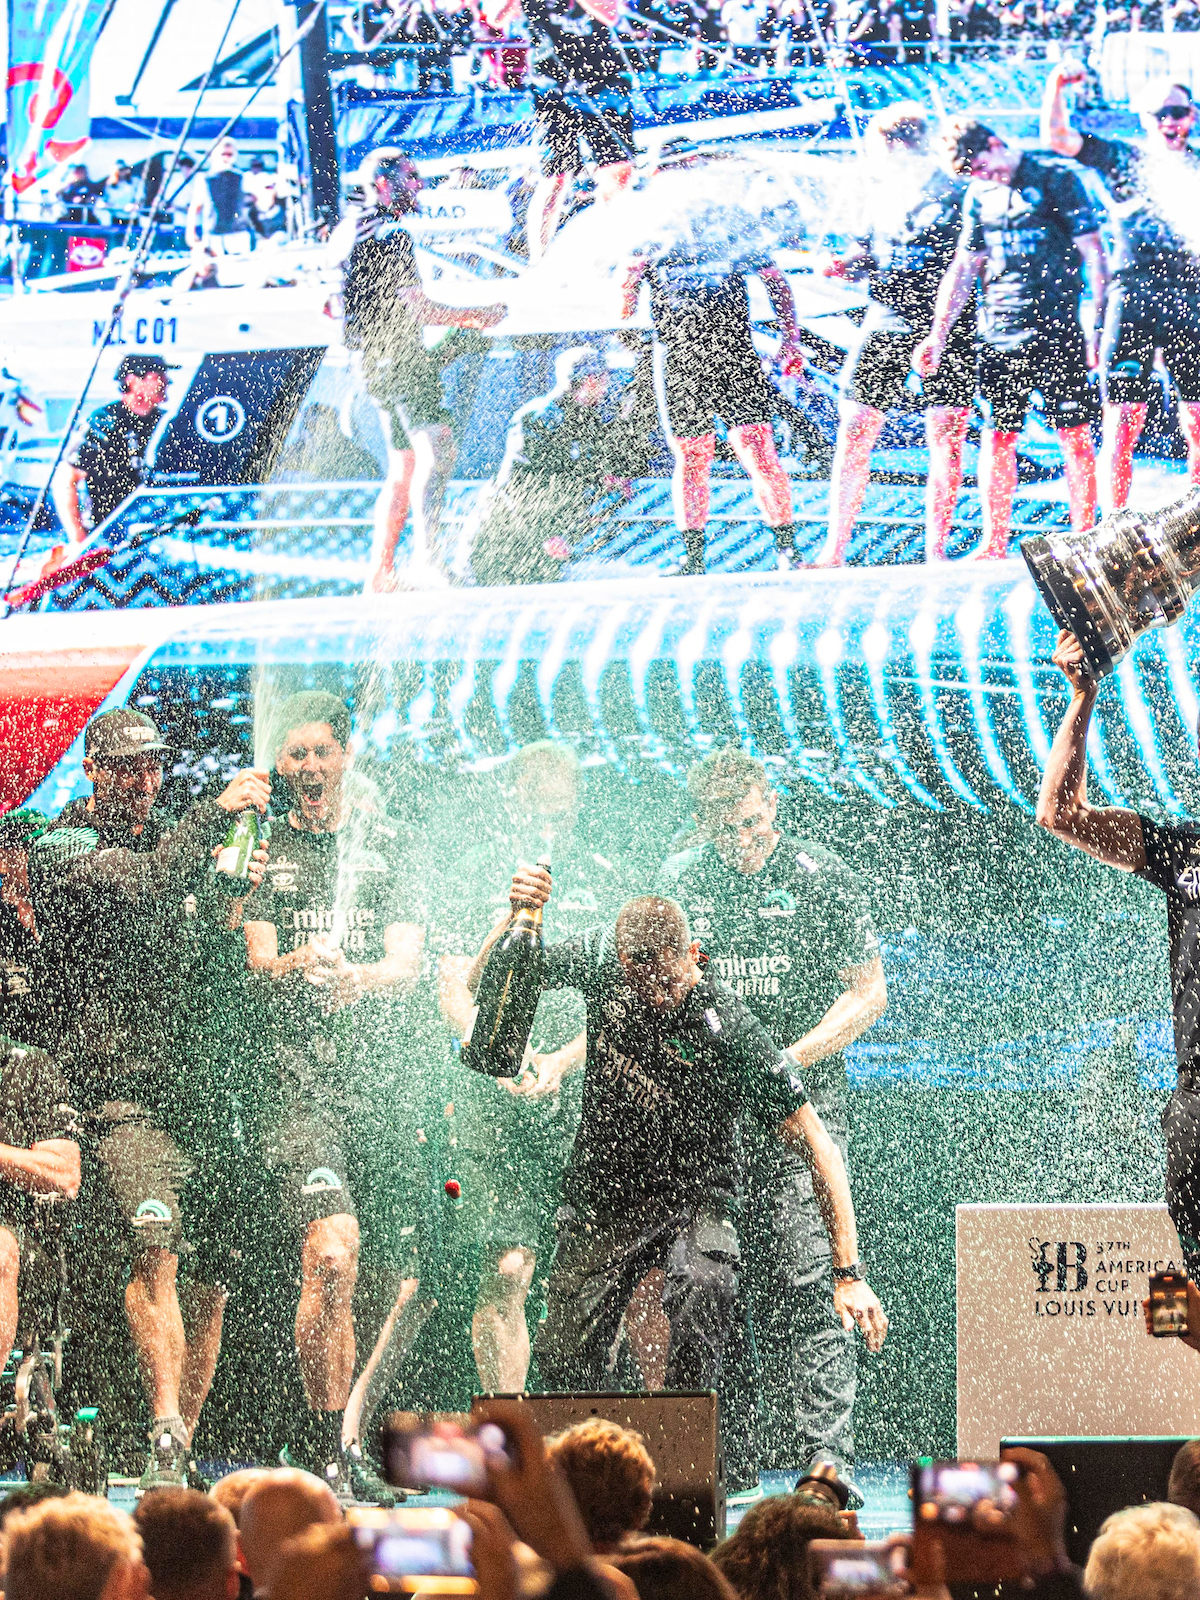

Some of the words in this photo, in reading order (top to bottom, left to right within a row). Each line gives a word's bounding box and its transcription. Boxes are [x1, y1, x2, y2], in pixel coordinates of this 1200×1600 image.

[713, 953, 792, 978] mirates
[1096, 1241, 1130, 1254] 37TH
[1096, 1280, 1130, 1293] CUP
[1035, 1300, 1096, 1317] LOUIS
